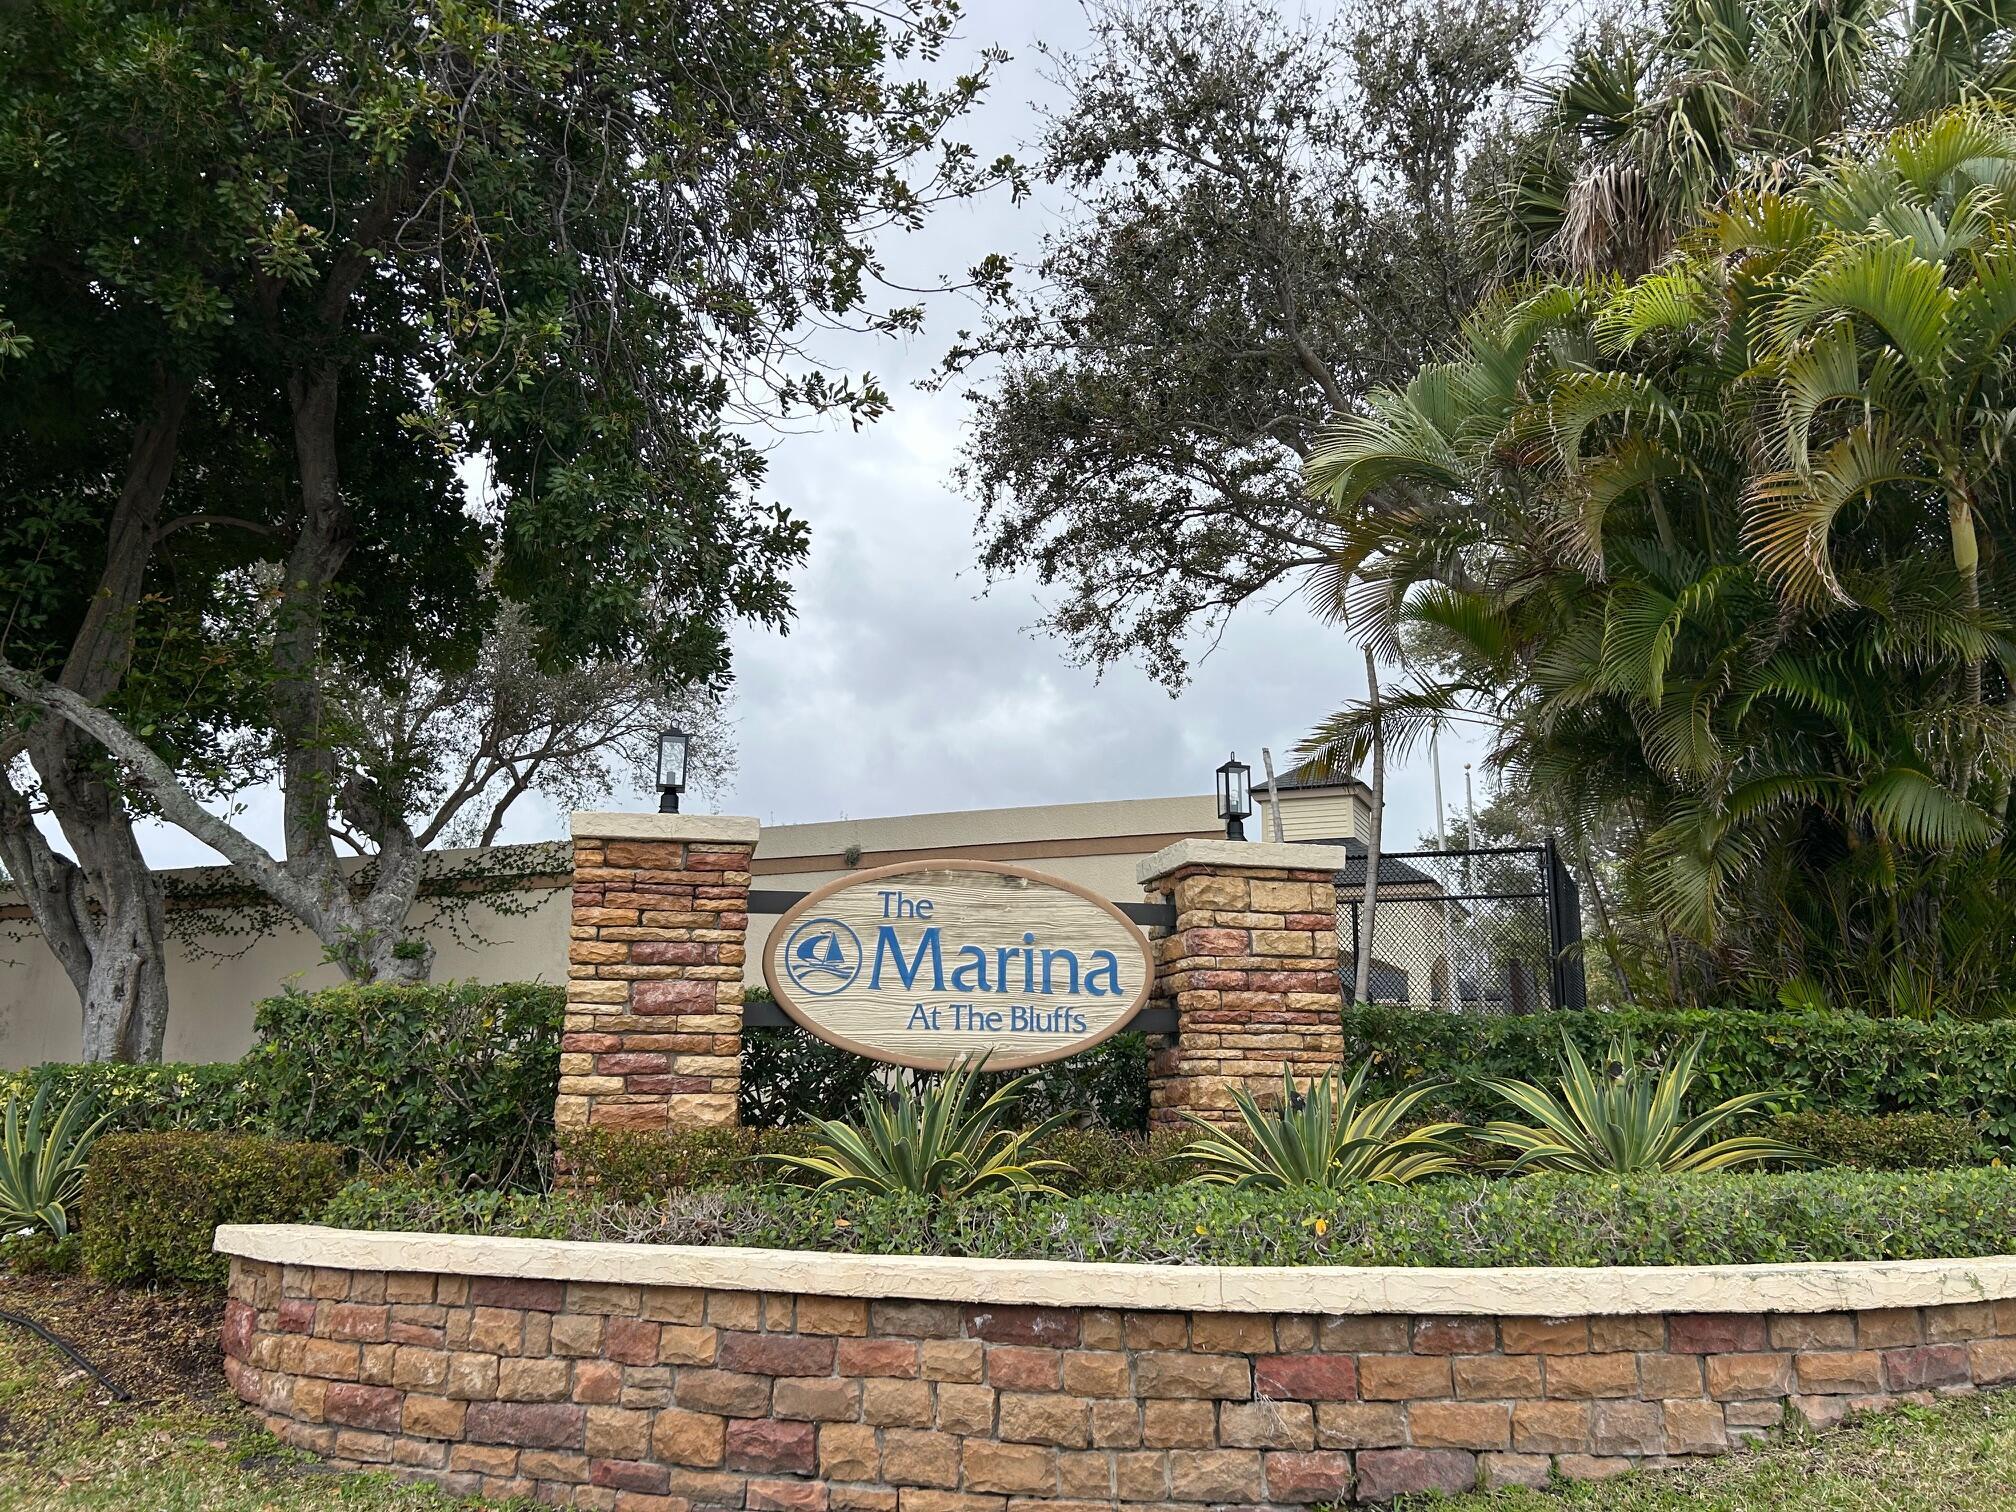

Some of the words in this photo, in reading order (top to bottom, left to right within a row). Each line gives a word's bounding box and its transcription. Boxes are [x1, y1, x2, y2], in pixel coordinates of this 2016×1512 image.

[878, 891, 934, 919] The
[868, 925, 1124, 997] Marina
[906, 1003, 941, 1030] At
[949, 1004, 1002, 1032] The
[1010, 1005, 1088, 1033] Bluffs
